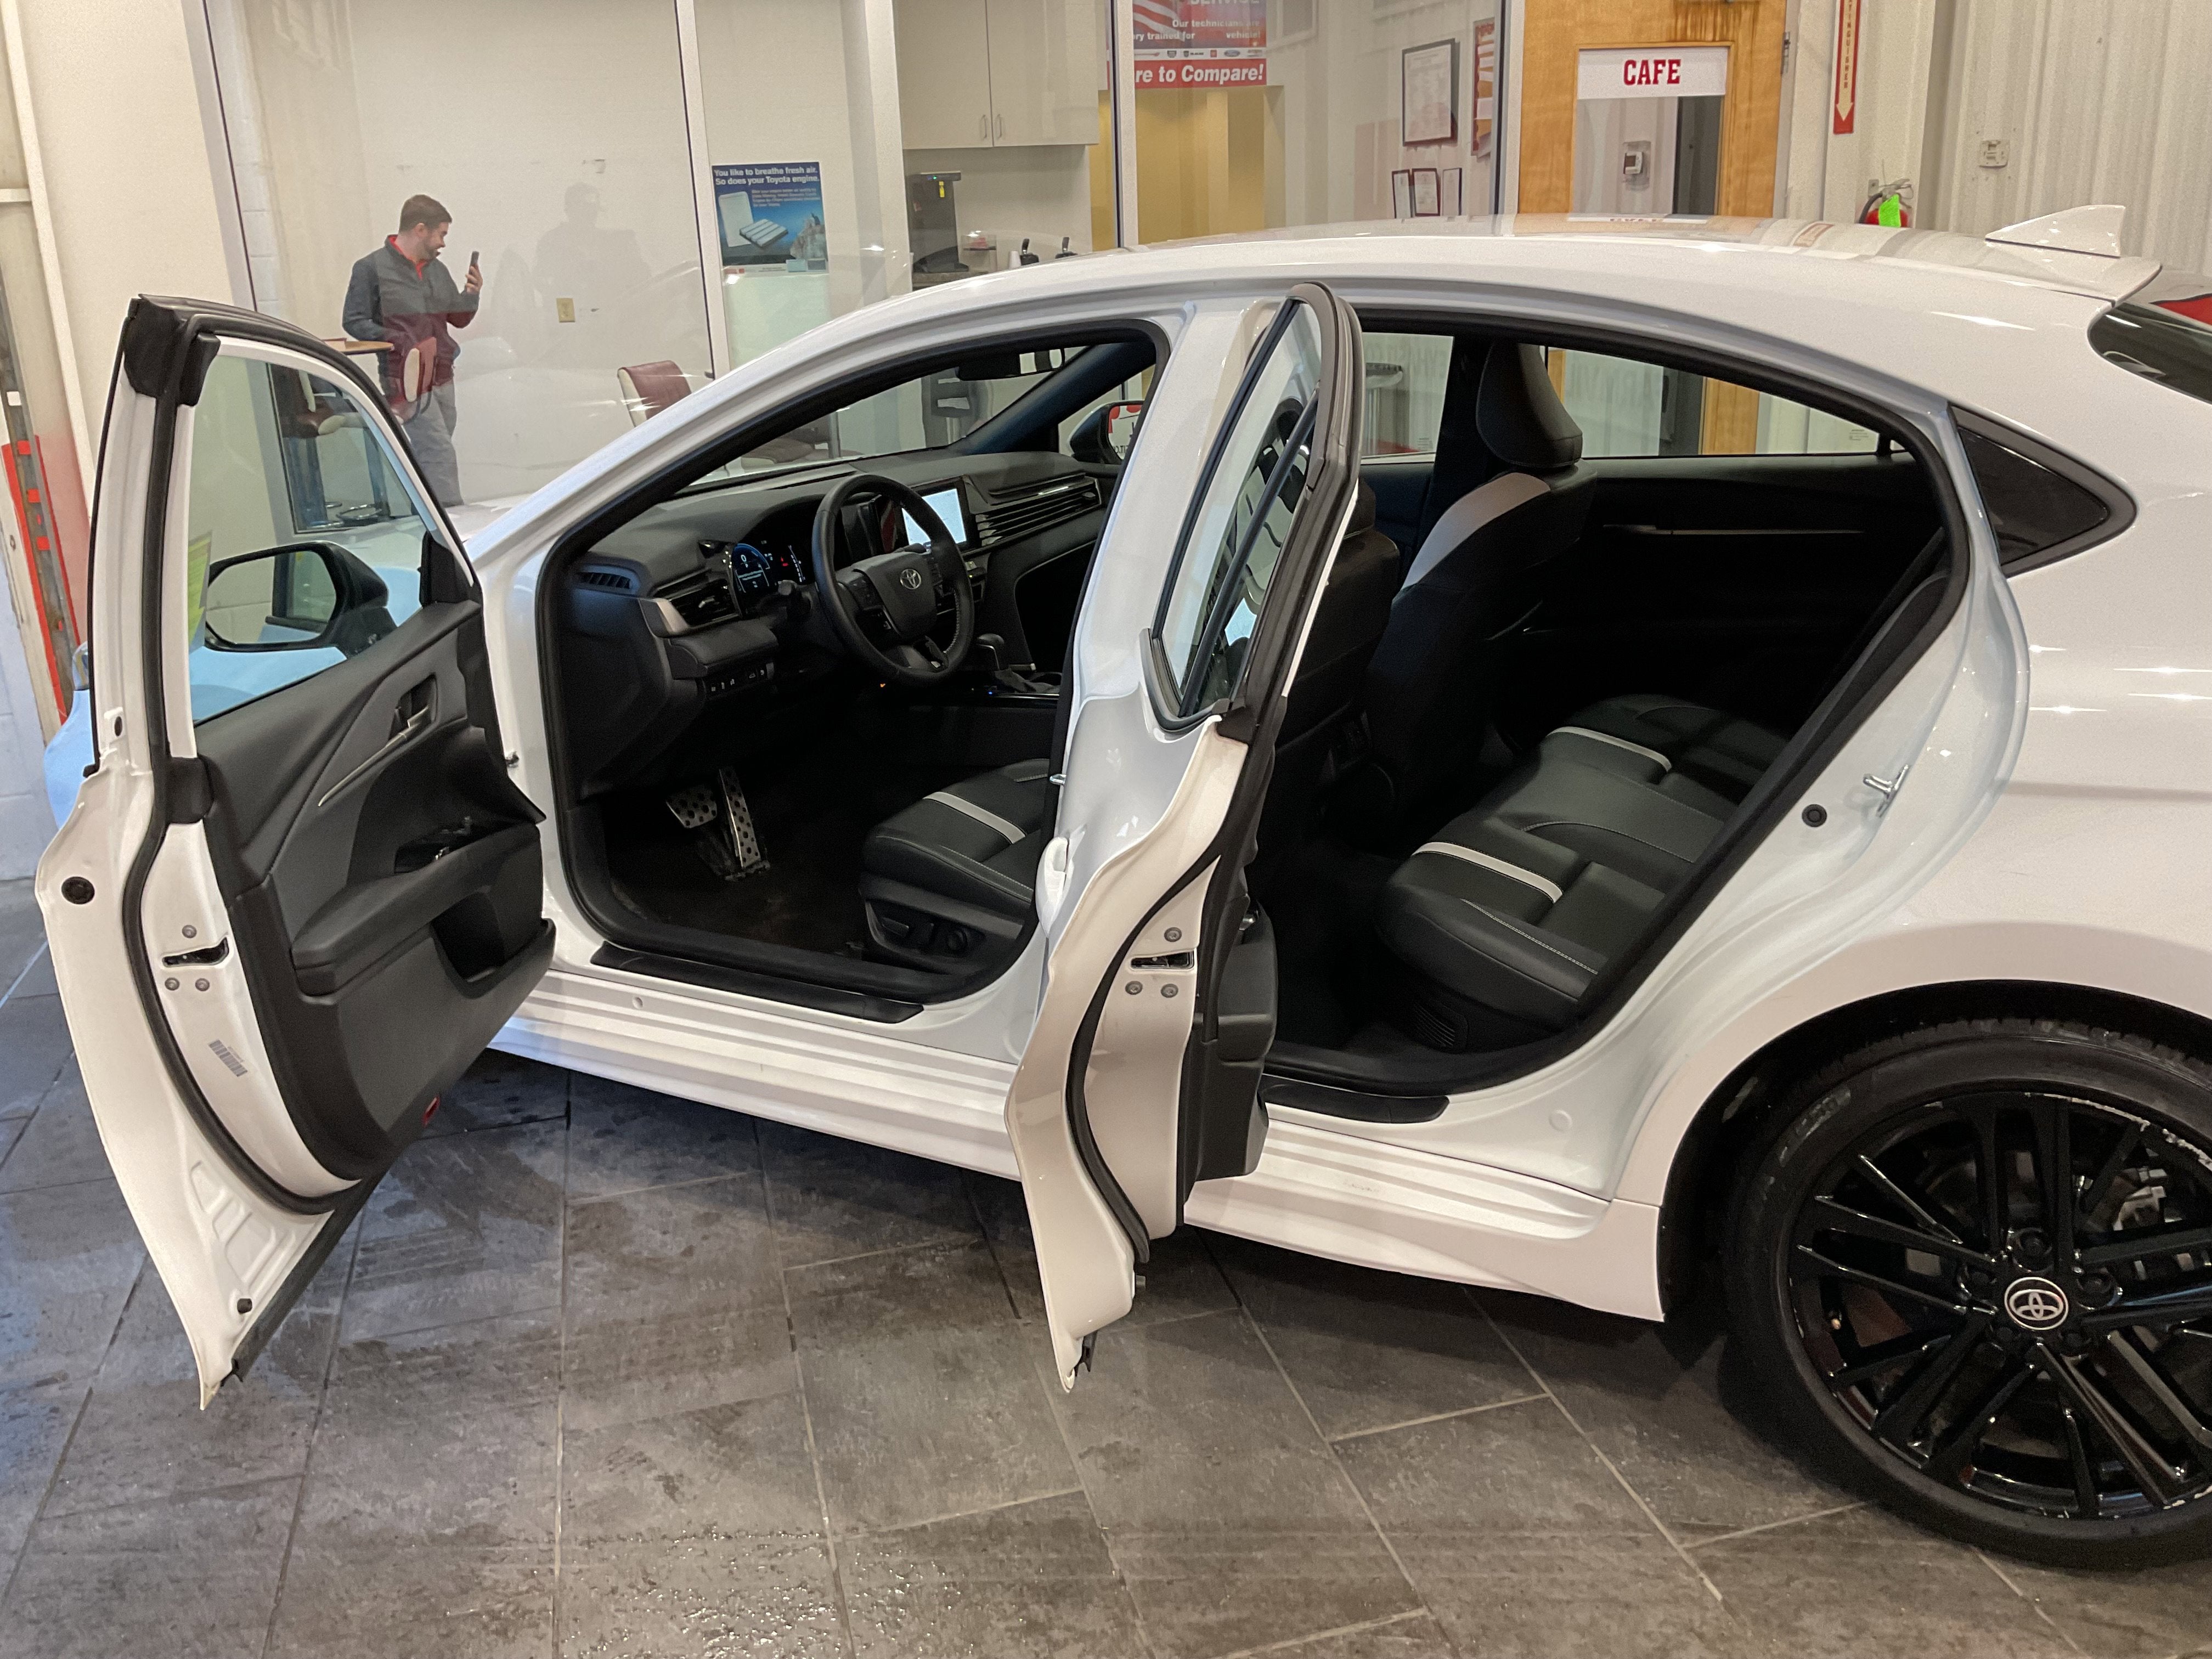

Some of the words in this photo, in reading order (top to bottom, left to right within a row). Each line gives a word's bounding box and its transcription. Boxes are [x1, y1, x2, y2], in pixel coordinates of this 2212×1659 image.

[1147, 31, 1180, 40] trained
[1181, 31, 1195, 42] for
[1159, 66, 1176, 83] to
[1181, 64, 1264, 85] Compare!
[1623, 59, 1681, 86] CAFE
[747, 178, 765, 186] your
[765, 176, 791, 184] Toyota
[792, 174, 820, 184] engine.
